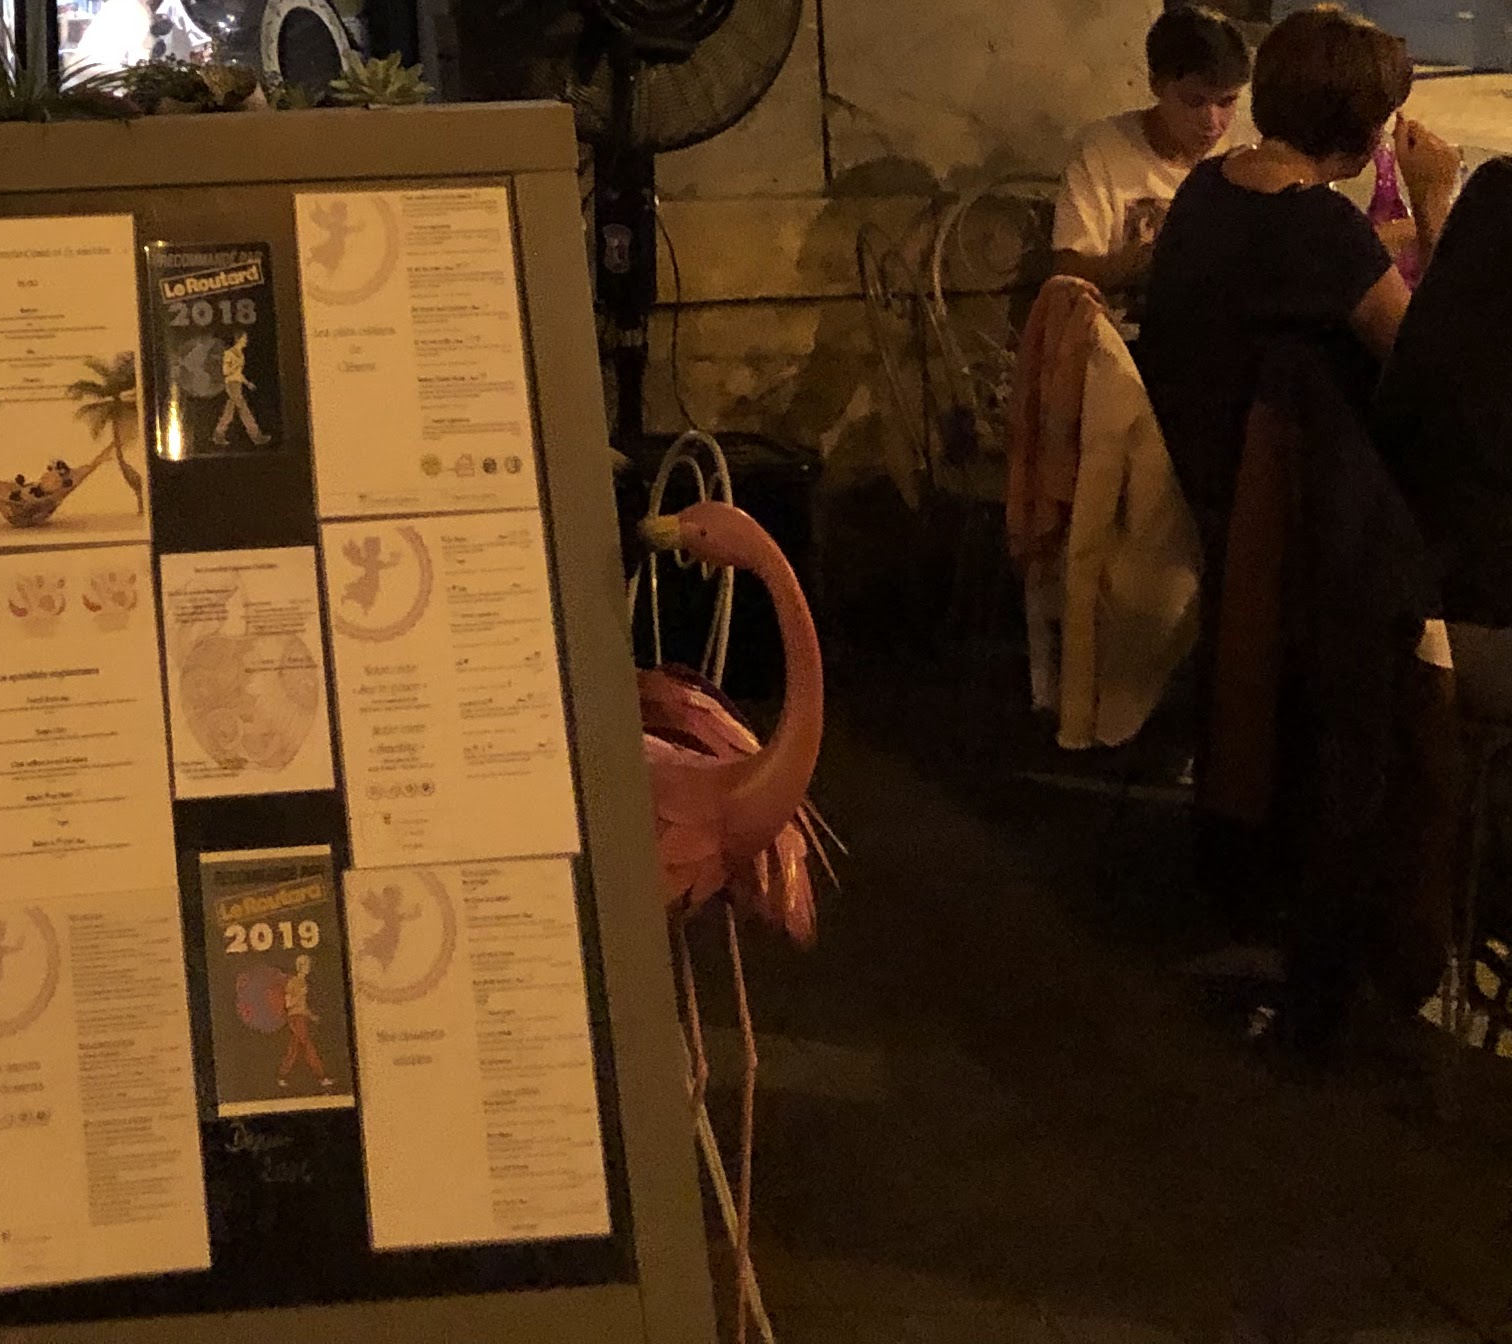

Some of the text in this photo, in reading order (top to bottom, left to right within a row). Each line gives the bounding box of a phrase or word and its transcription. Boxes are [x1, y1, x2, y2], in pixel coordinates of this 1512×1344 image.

[185, 265, 259, 293] Routard
[168, 298, 257, 327] 2018
[223, 920, 320, 953] 2019
